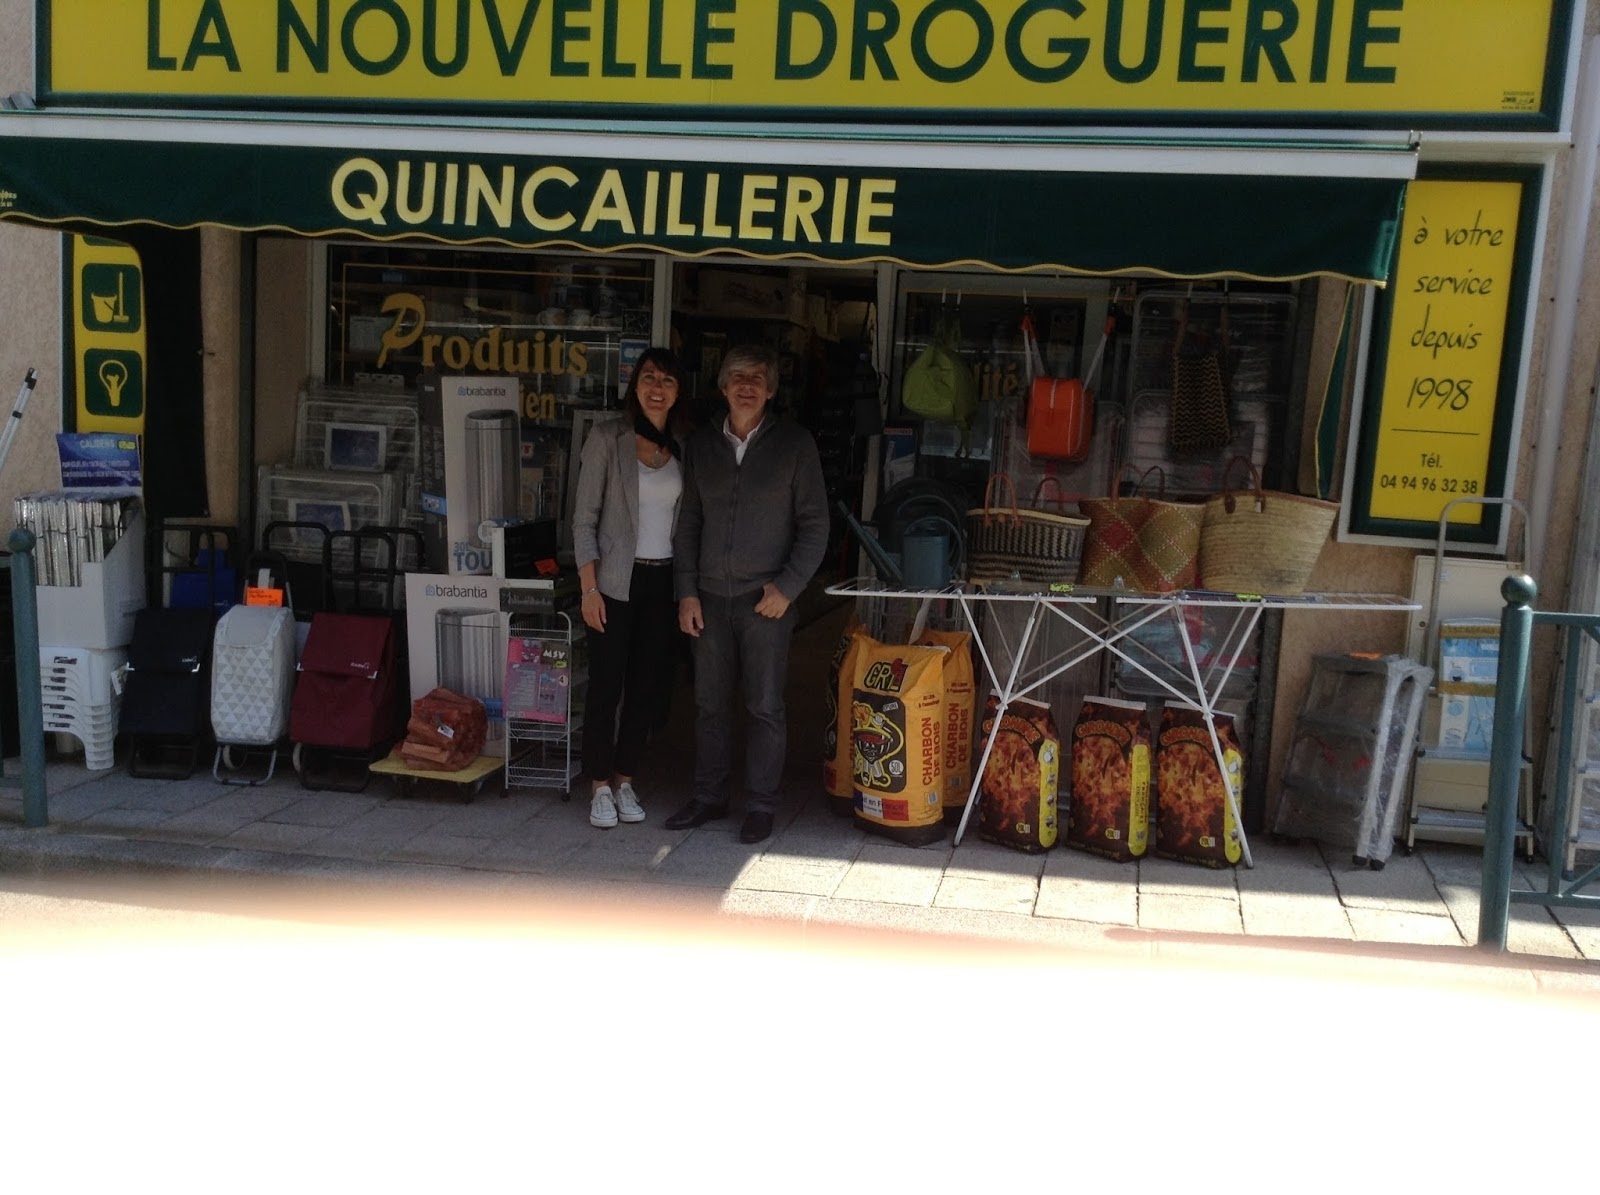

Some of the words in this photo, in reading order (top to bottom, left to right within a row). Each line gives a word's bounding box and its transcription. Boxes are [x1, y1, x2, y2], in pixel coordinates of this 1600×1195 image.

[147, 0, 241, 72] LA
[276, 0, 737, 79] NOUVELLE
[774, 0, 1404, 83] DROGUERIE
[330, 156, 897, 247] QUINCAILLERIE
[1413, 217, 1428, 246] à
[1445, 210, 1504, 247] votre
[1413, 269, 1493, 295] service
[376, 292, 588, 377] Produits
[1411, 304, 1482, 359] depuis
[466, 386, 506, 397] brabantia
[1407, 377, 1473, 411] 1998
[1420, 453, 1442, 469] Tél.
[1381, 474, 1397, 489] 04
[1402, 475, 1417, 490] 94
[1422, 477, 1437, 491] 96
[1441, 478, 1458, 493] 32
[1461, 479, 1478, 495] 38
[436, 584, 488, 598] brabantia
[945, 703, 959, 769] CHARBON
[959, 708, 968, 740] BOIS
[922, 717, 933, 786] CHARBON
[958, 743, 967, 763] DE
[933, 759, 940, 778] DE
[869, 799, 877, 807] en
